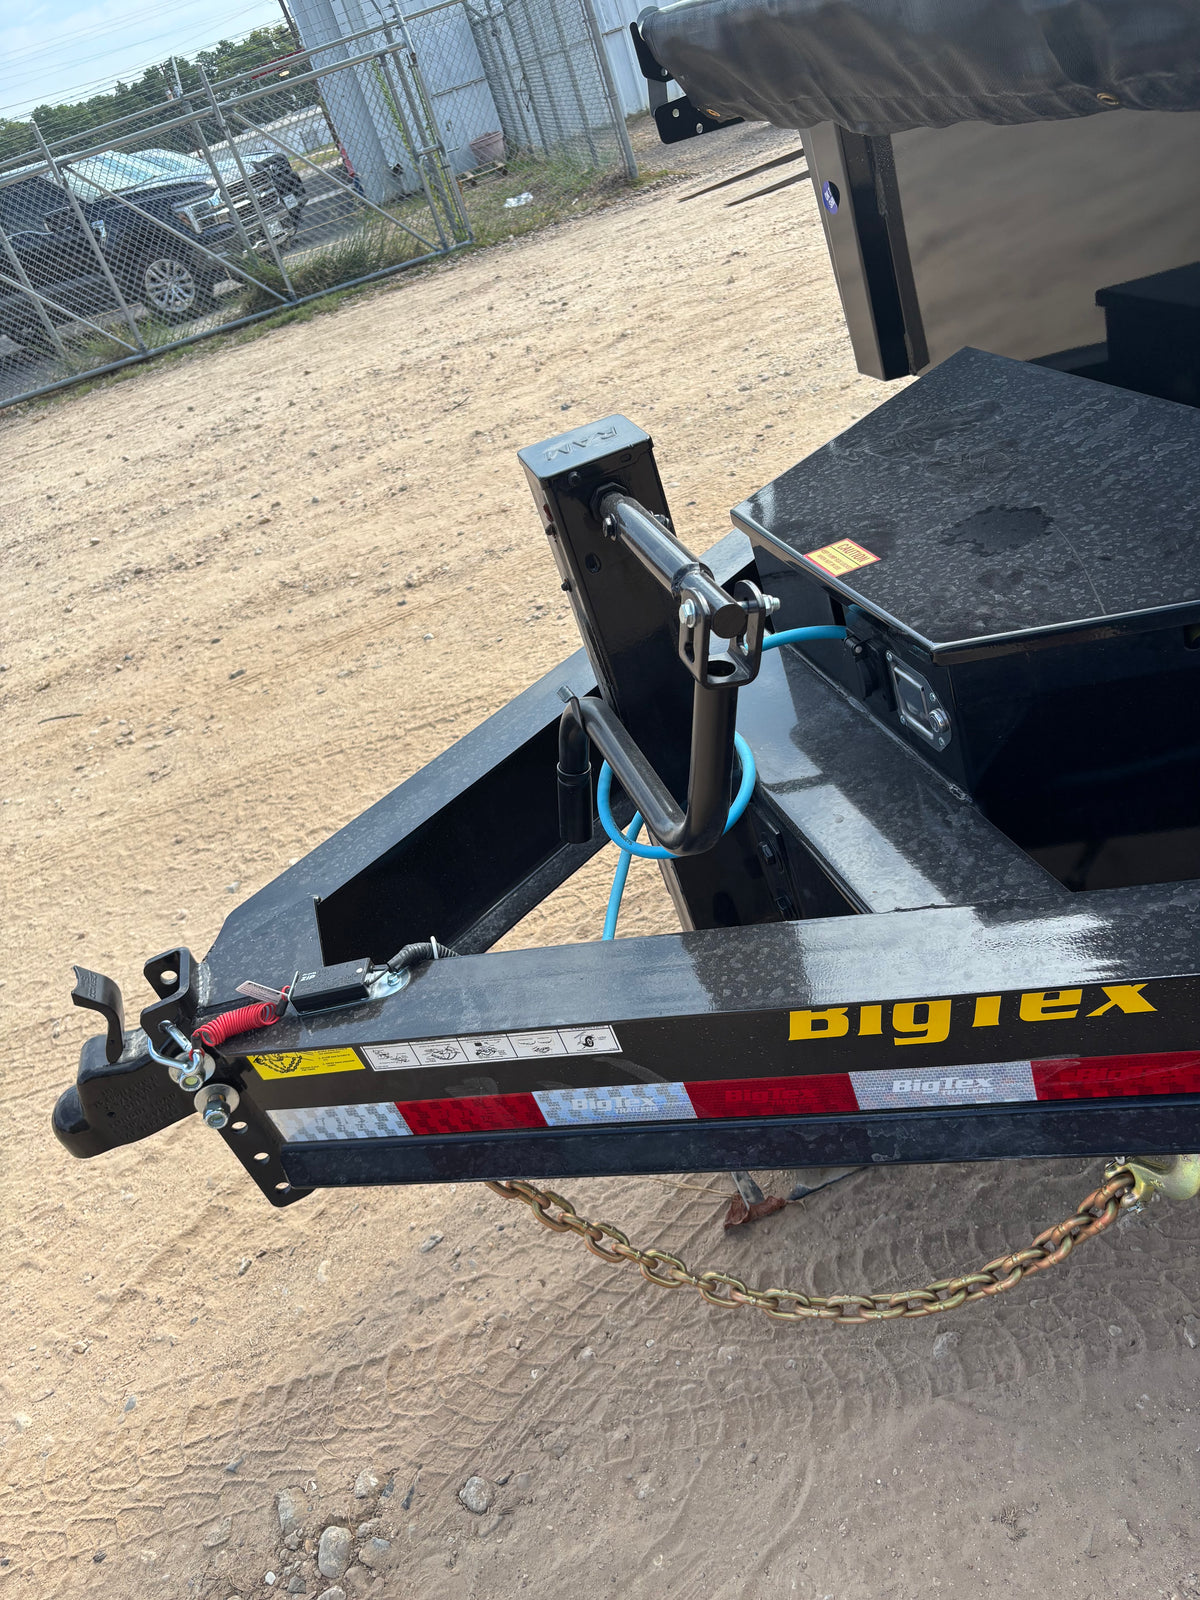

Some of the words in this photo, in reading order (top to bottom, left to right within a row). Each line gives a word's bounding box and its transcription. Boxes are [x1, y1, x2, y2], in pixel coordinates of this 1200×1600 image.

[543, 425, 618, 462] RAM
[836, 543, 871, 563] CAUTION
[891, 1076, 994, 1094] BigTex
[570, 1096, 656, 1112] BigTex
[614, 1105, 659, 1115] TRAILERS
